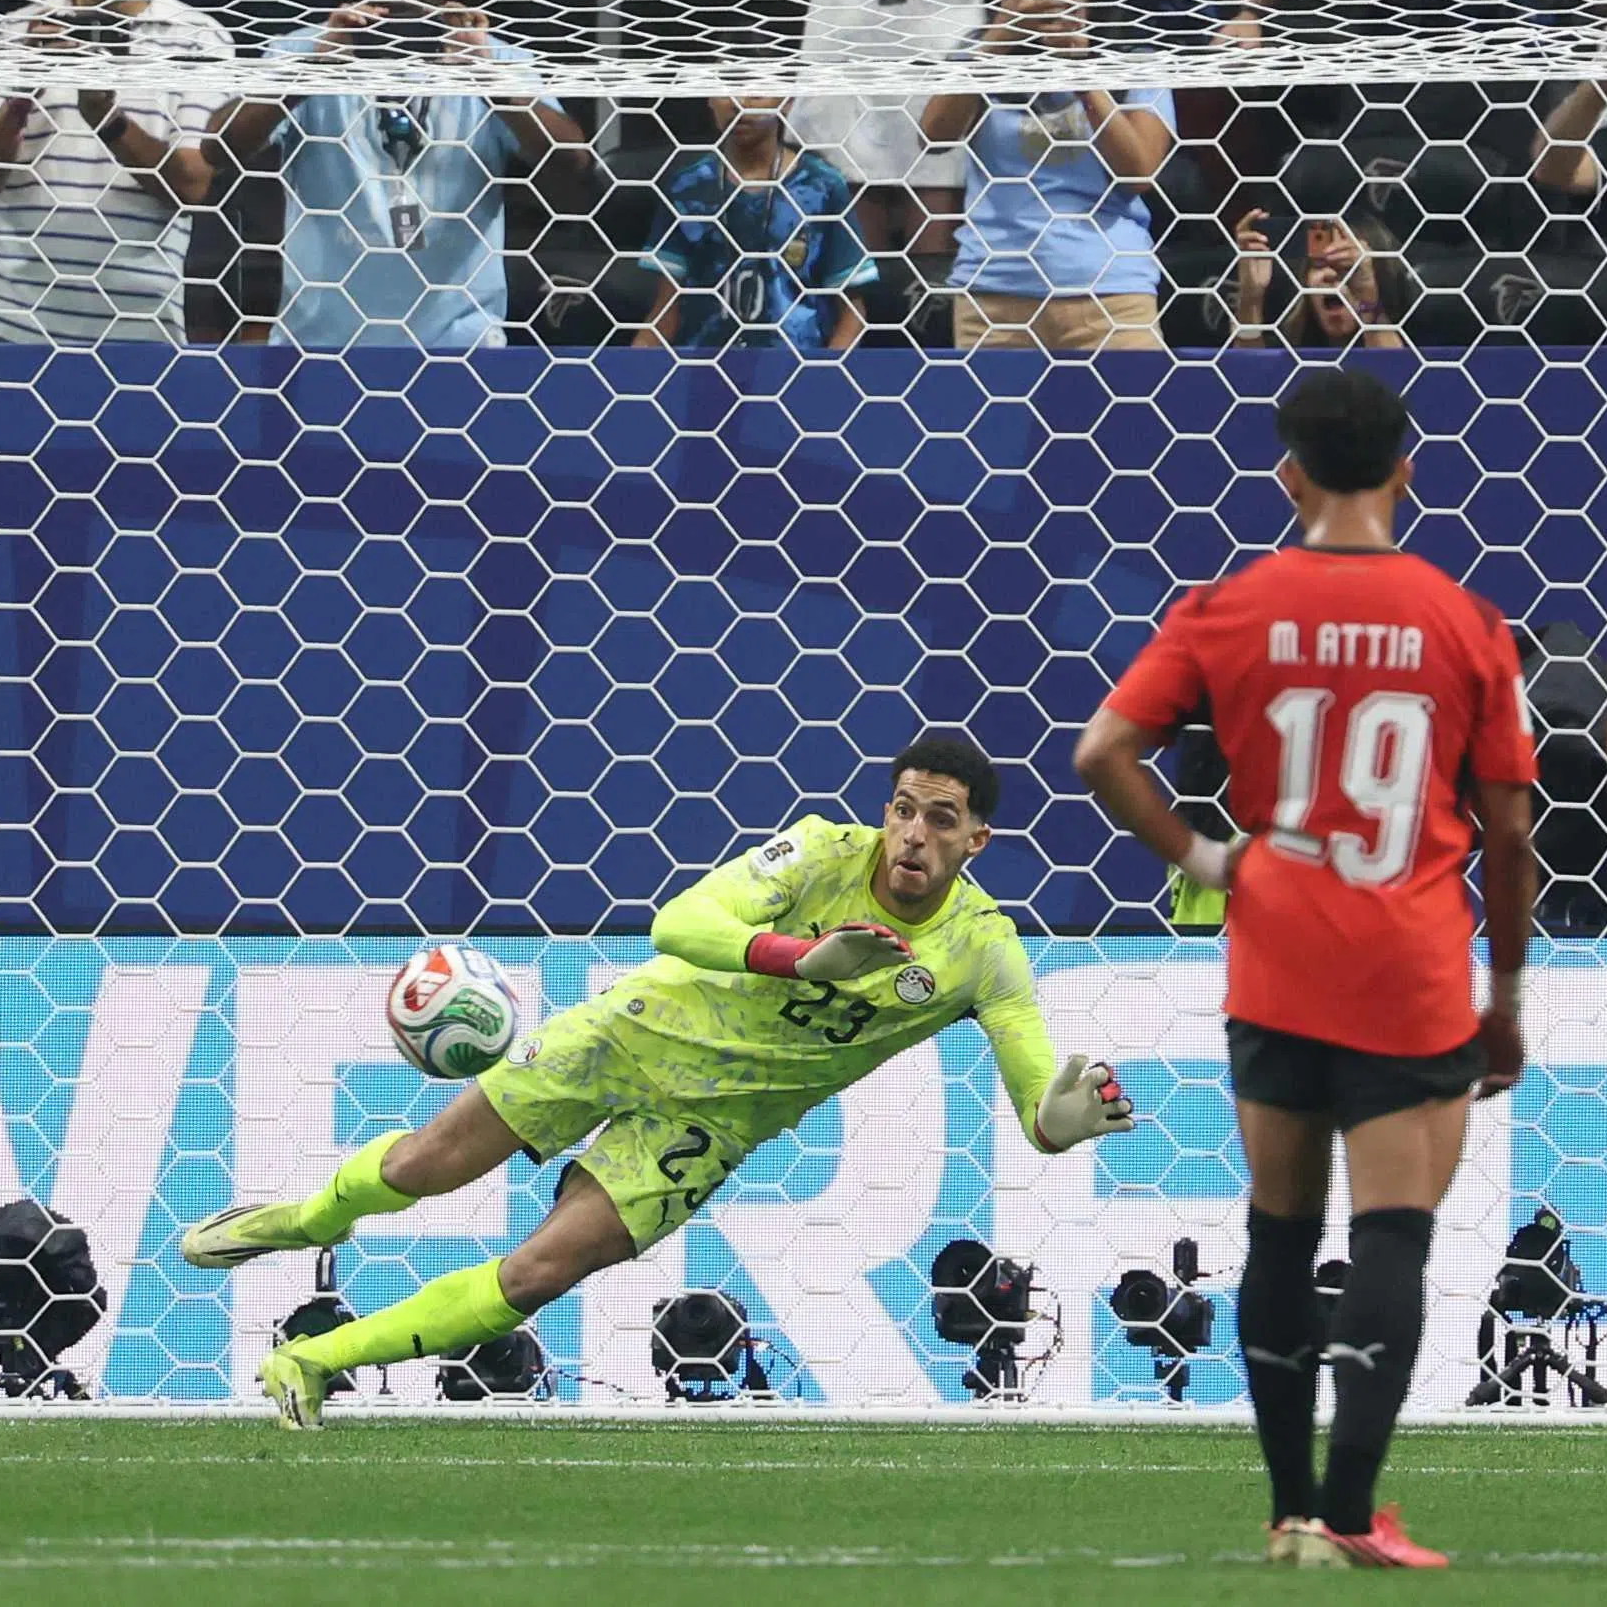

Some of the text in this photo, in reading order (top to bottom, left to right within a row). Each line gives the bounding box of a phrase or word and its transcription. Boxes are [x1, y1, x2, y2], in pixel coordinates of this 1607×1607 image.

[1268, 620, 1424, 672] M. ATTIA
[1265, 687, 1437, 889] 19
[778, 978, 879, 1045] 23
